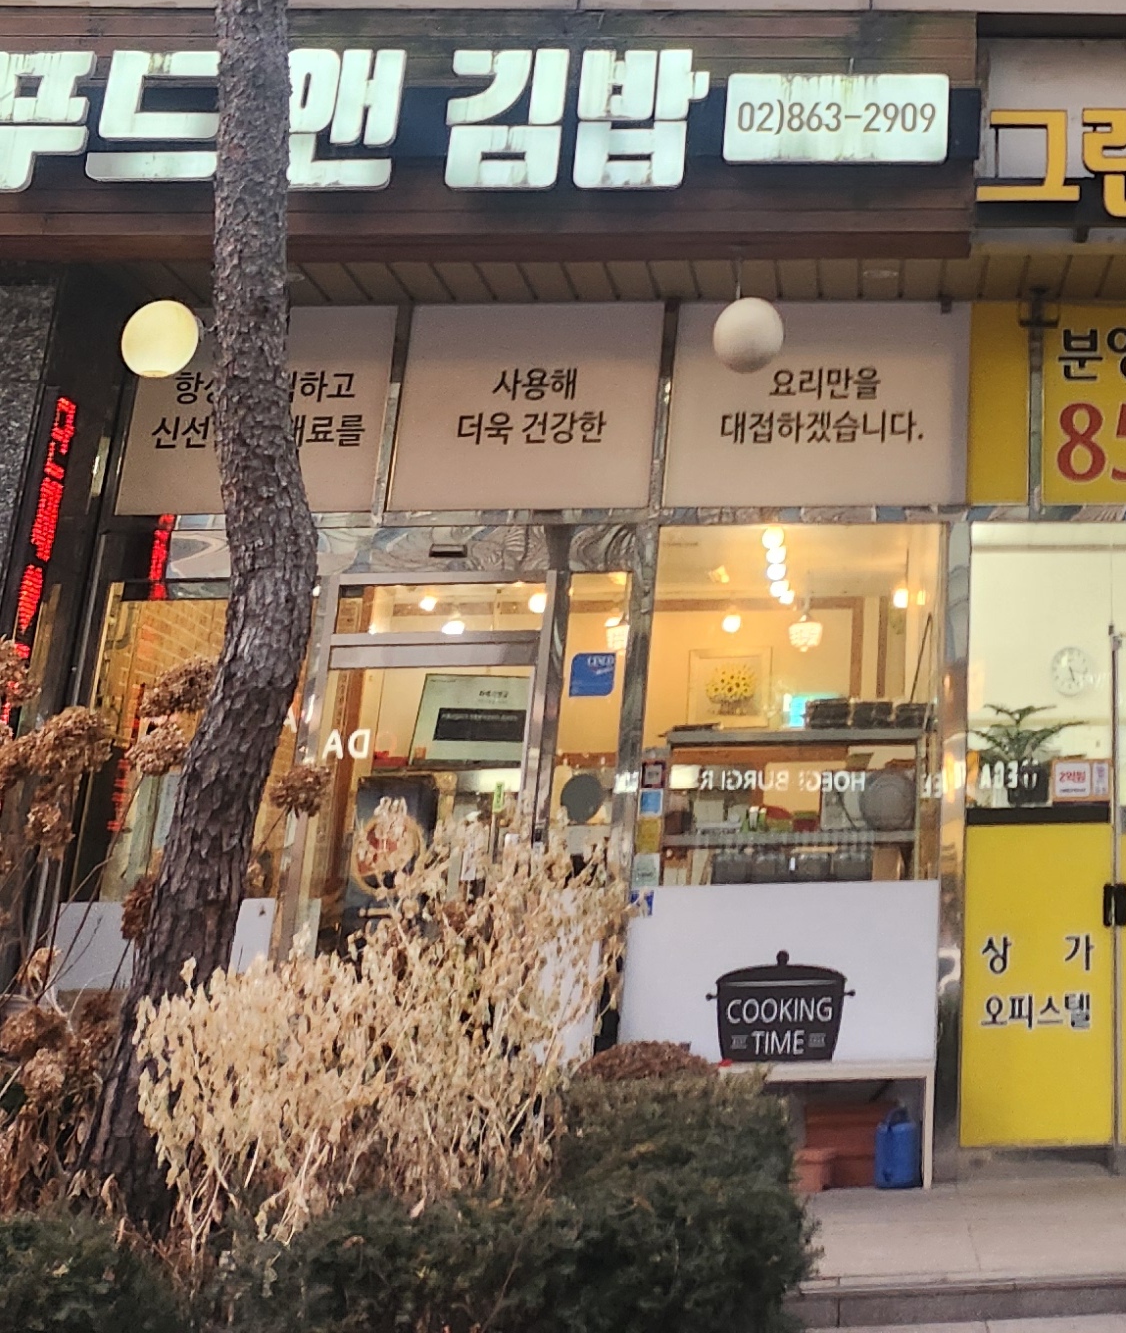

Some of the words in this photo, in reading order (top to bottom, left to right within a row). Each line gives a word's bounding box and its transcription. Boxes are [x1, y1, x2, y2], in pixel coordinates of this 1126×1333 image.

[445, 49, 709, 190] 김밥
[737, 100, 936, 134] 02)863-2909
[493, 368, 578, 401] 사용해
[769, 366, 881, 400] 요리만을
[152, 415, 217, 449] 신선
[457, 412, 514, 445] 더욱
[521, 410, 608, 445] 건강한
[720, 410, 924, 444] 대접하겠습니다.
[727, 997, 833, 1024] COOKING
[981, 993, 1091, 1029] 오피스텔
[751, 1030, 805, 1055] TIME
